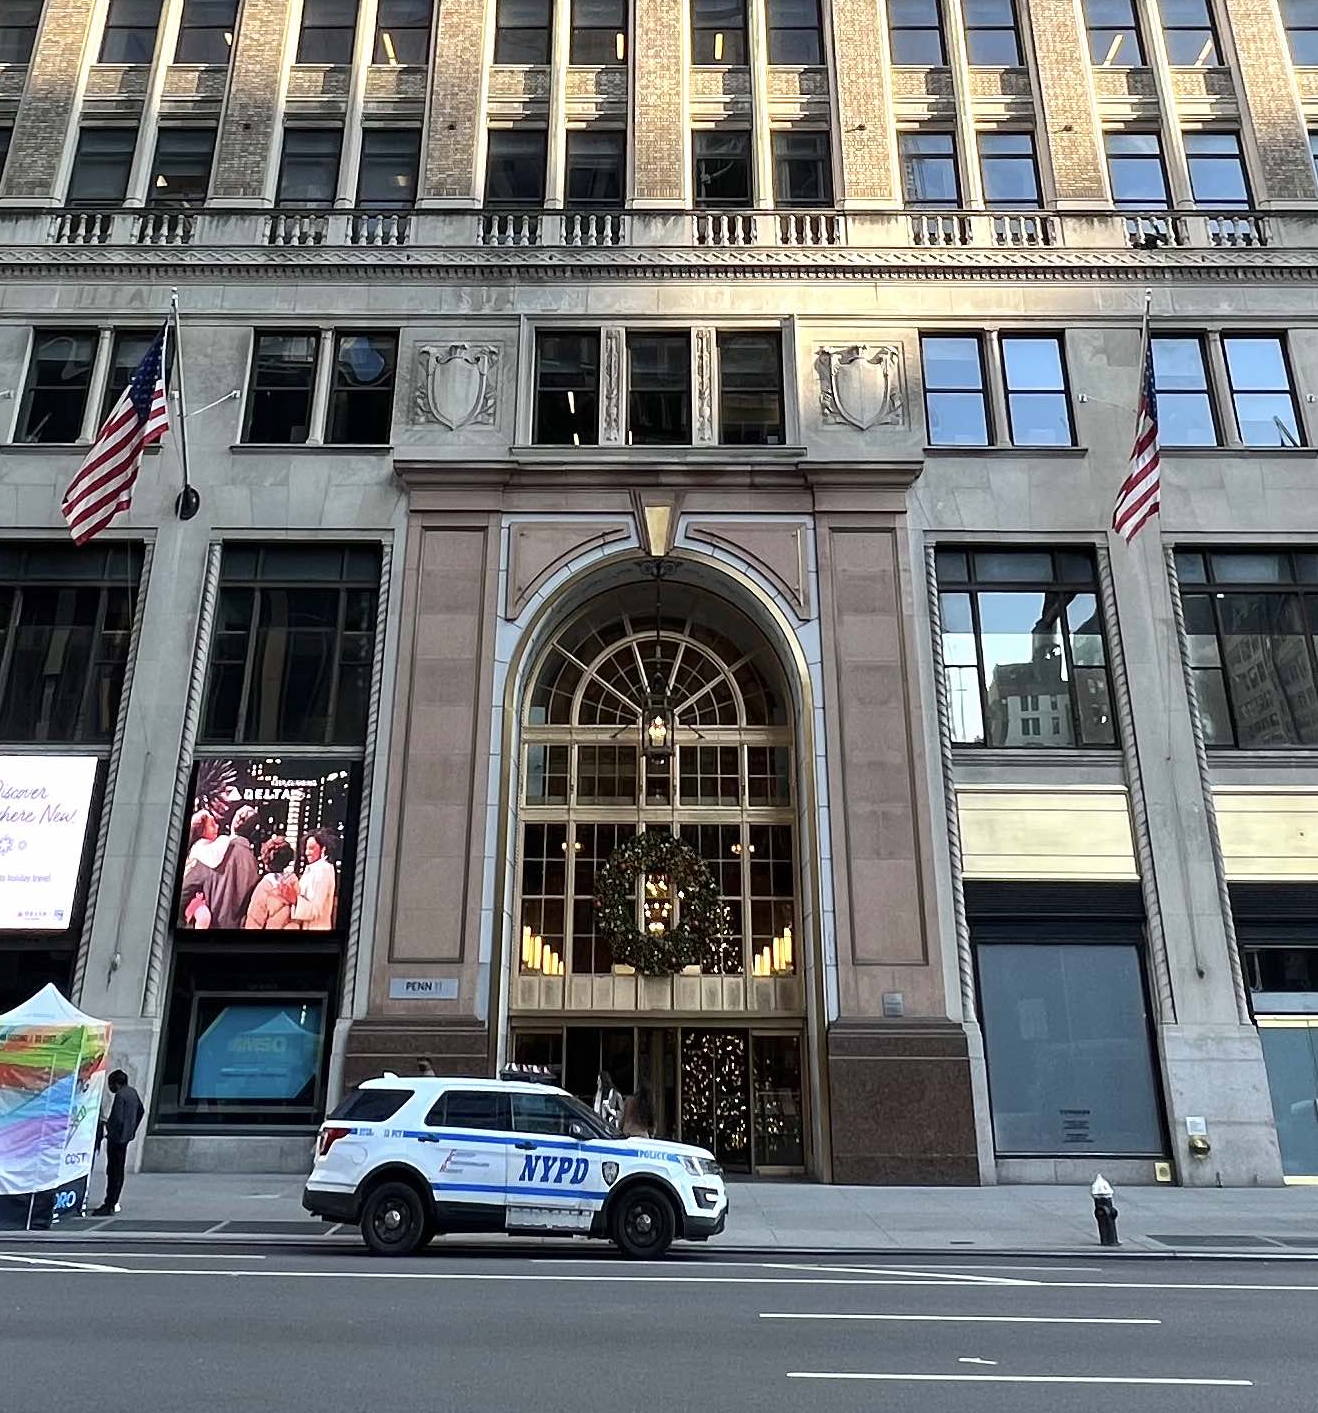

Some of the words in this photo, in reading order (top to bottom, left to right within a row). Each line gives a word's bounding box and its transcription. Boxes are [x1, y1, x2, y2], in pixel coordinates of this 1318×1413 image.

[243, 788, 289, 800] DELTA
[406, 981, 433, 991] PENN
[519, 1154, 589, 1185] NYPD
